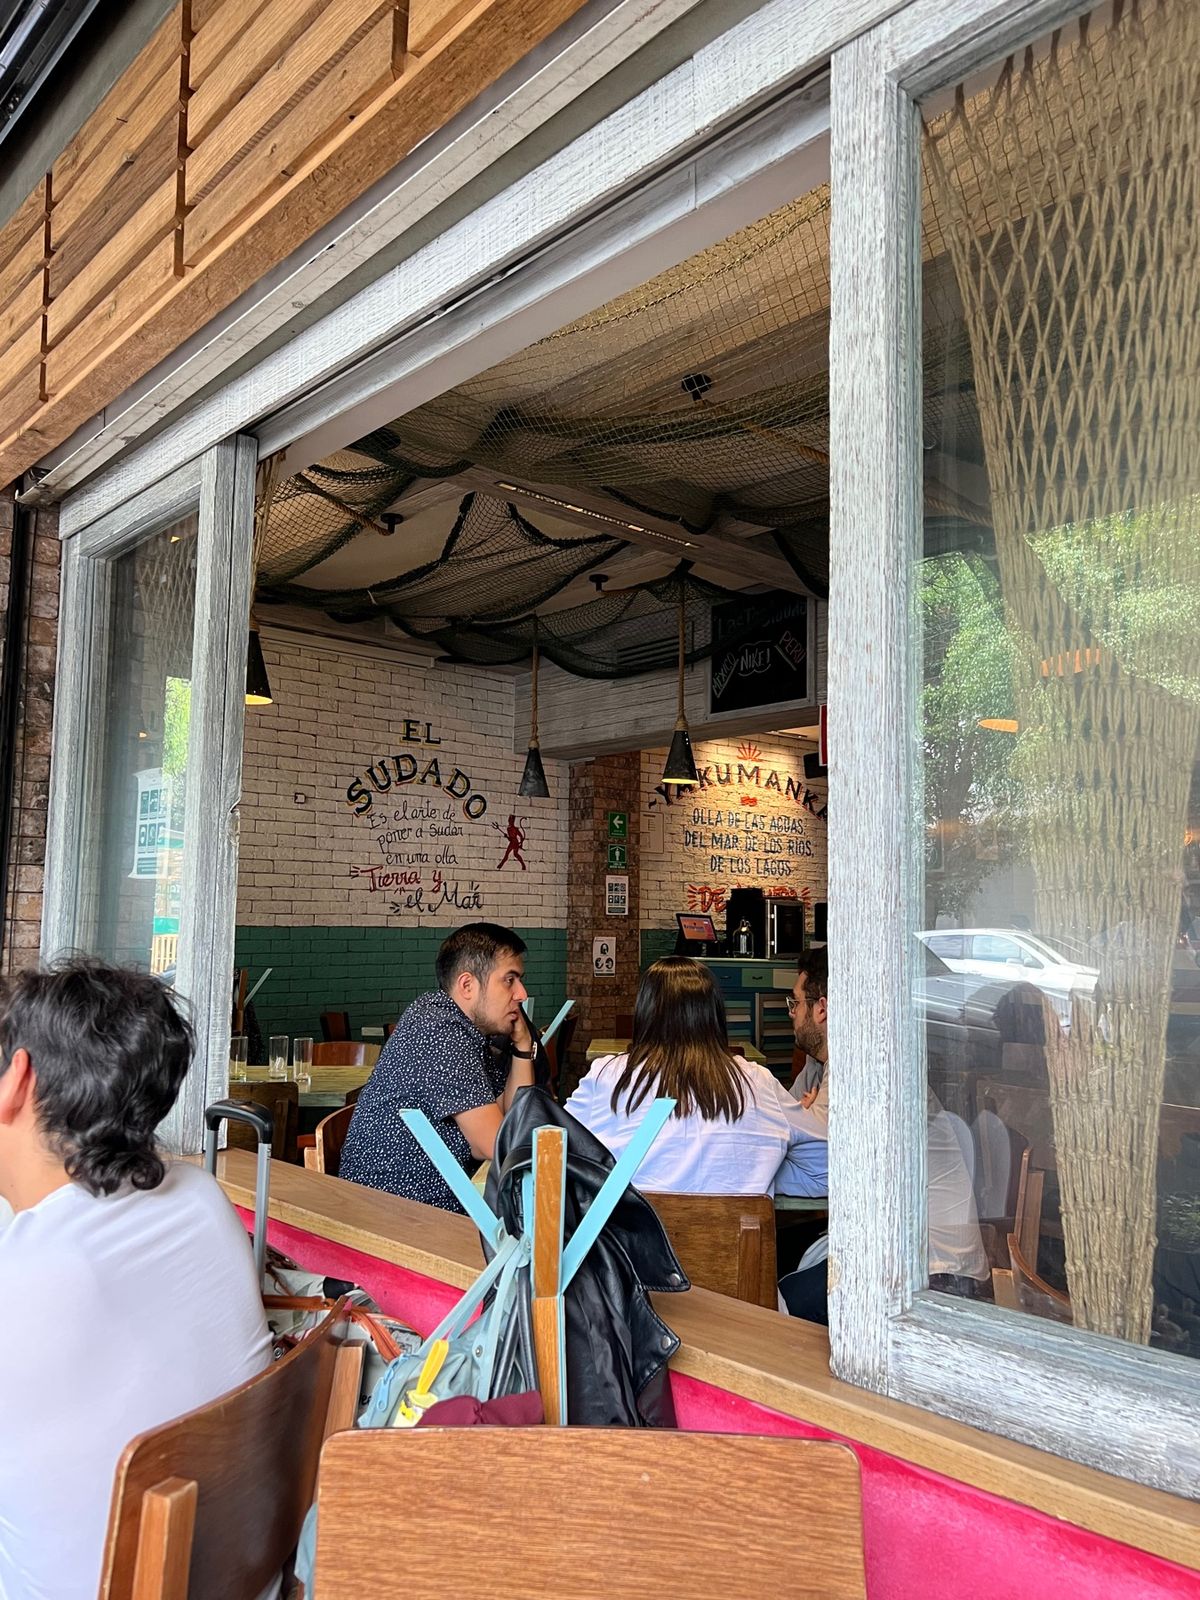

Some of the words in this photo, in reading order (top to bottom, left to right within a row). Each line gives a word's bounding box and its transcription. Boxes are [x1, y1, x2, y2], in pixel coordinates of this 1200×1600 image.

[401, 719, 441, 745] EL
[346, 753, 487, 819] SUDADO
[367, 812, 387, 830] Es
[394, 800, 409, 821] el
[411, 800, 437, 819] arte
[442, 804, 456, 823] de
[692, 807, 723, 827] OLLA
[728, 811, 741, 828] DE
[745, 813, 765, 831] LAS
[377, 827, 412, 854] poner
[415, 827, 424, 838] a
[684, 830, 707, 848] DEL
[711, 833, 739, 850] MAR
[745, 836, 758, 852] DE
[763, 837, 783, 854] LOS
[386, 853, 403, 865] en
[407, 852, 430, 865] una
[435, 845, 459, 865] olla
[710, 854, 724, 873] DE
[730, 856, 751, 875] LOS
[756, 858, 792, 877] LAGOS
[360, 865, 422, 893] Tierra
[431, 869, 443, 894] y
[403, 887, 424, 913] el
[428, 881, 483, 912] Mar
